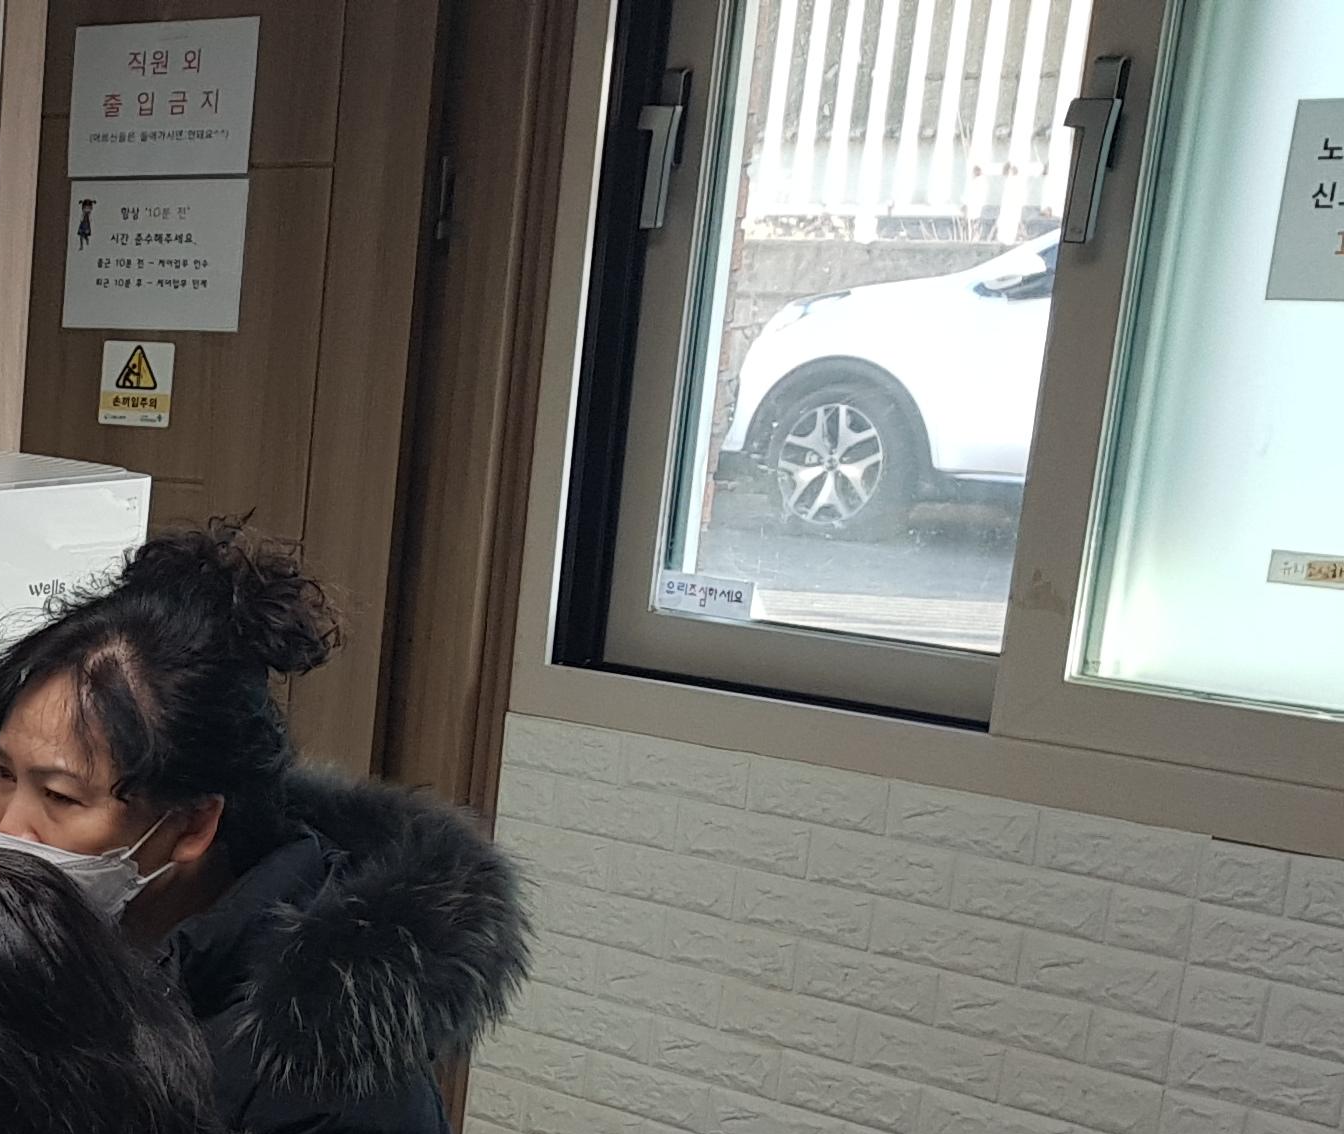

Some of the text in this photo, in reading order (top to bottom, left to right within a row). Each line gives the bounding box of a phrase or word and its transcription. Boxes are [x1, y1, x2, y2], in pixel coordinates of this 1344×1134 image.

[127, 48, 202, 76] 직원 외
[1311, 181, 1344, 209] 신
[110, 232, 129, 246] 시간
[115, 258, 132, 269] 10분
[114, 278, 131, 289] 10분
[28, 578, 66, 597] wells
